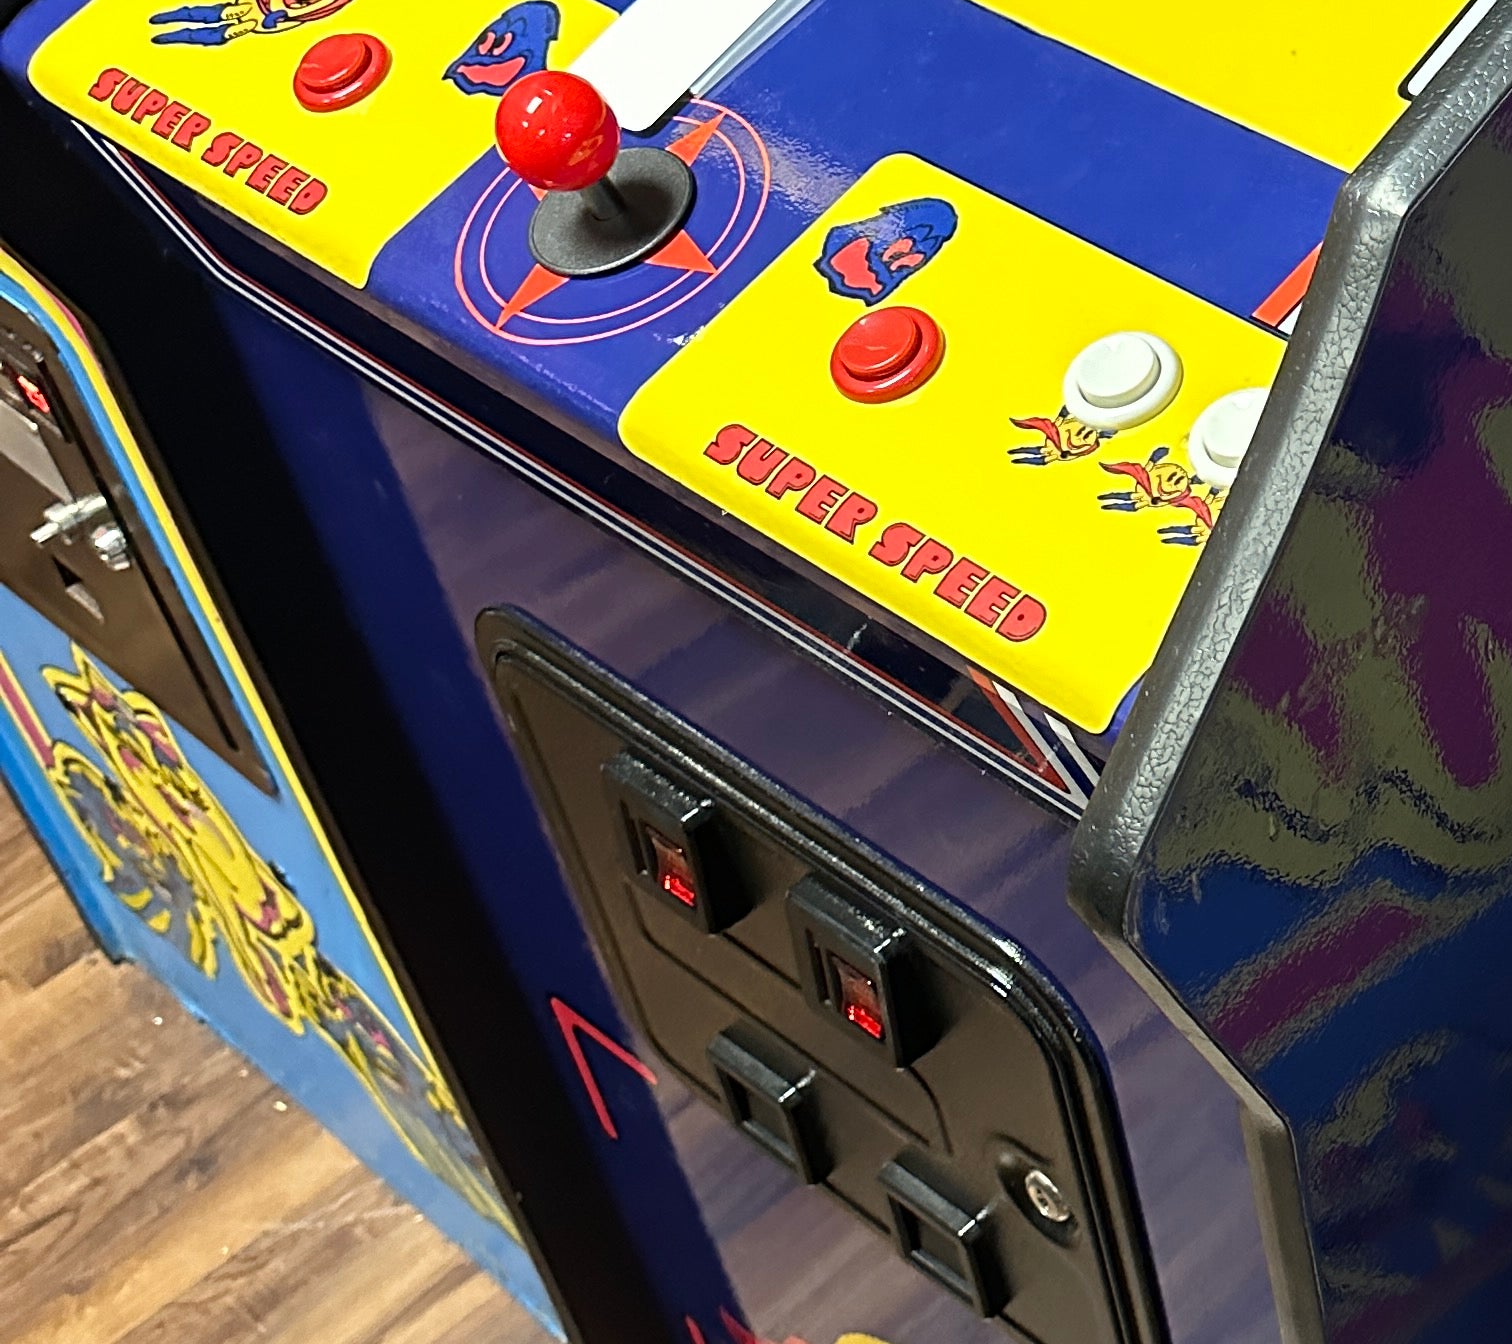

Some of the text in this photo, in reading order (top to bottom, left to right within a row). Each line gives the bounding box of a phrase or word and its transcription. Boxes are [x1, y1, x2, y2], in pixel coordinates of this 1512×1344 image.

[88, 67, 329, 216] SUPER SPEED
[702, 423, 1048, 642] SUPER SPEED
